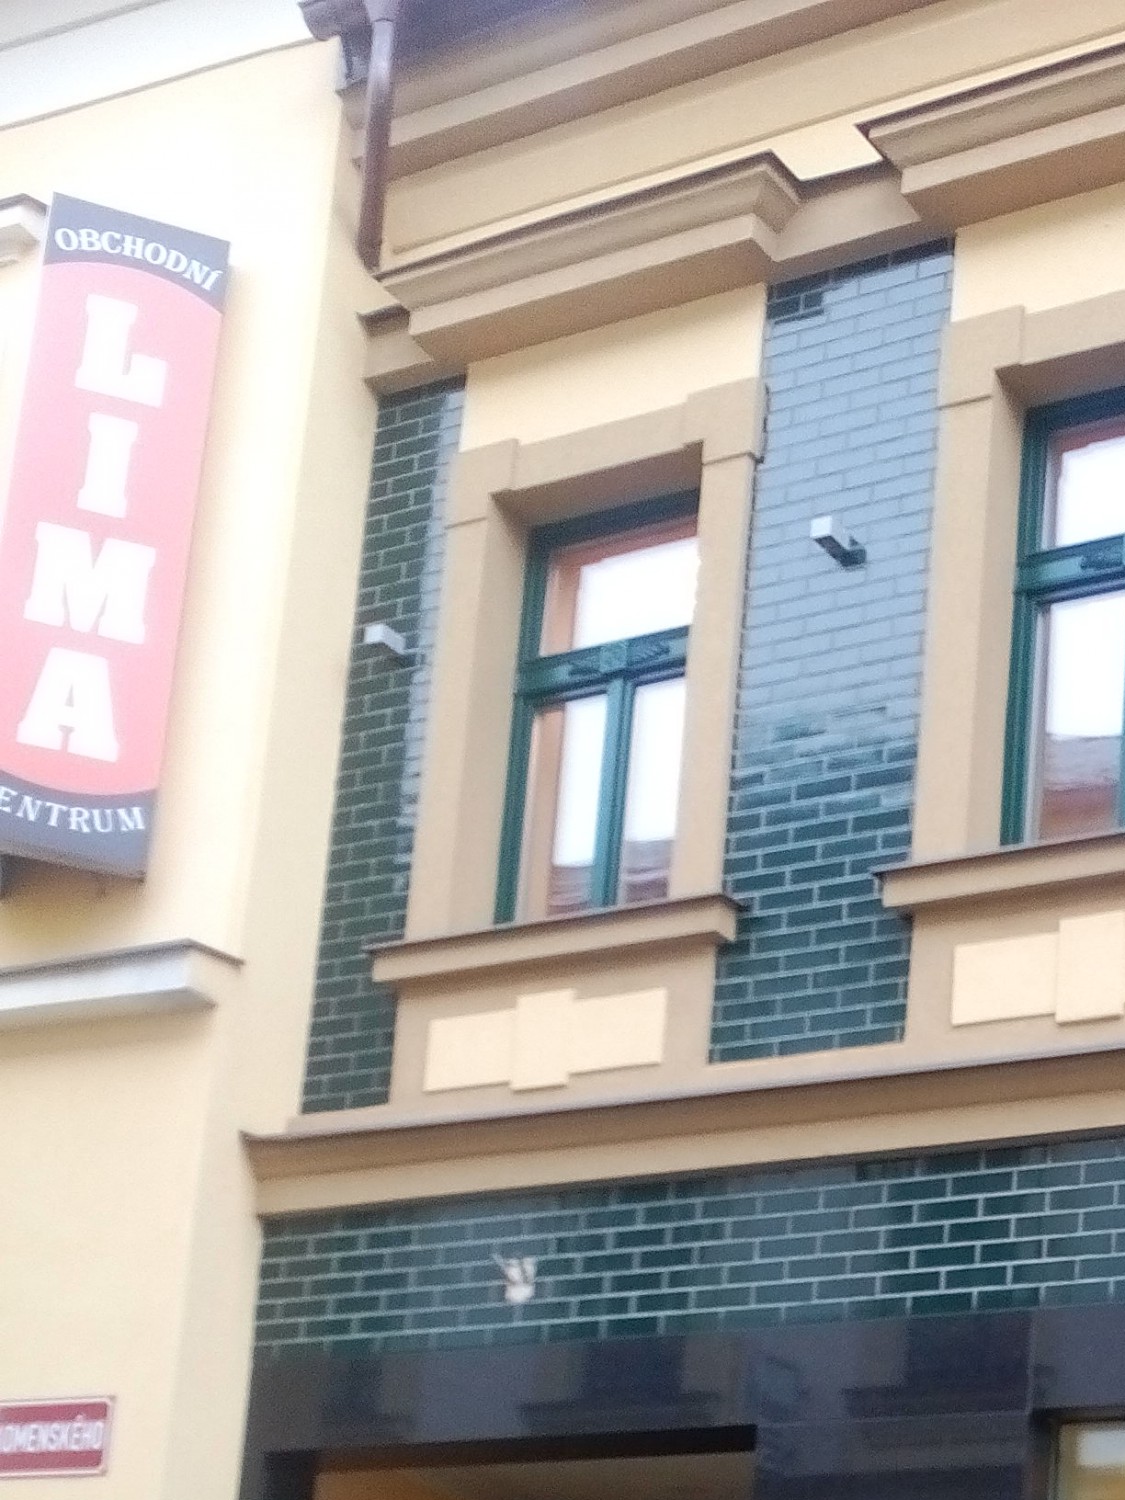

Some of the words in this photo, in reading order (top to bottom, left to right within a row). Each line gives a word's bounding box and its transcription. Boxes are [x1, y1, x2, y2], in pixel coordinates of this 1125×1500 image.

[54, 227, 223, 291] OBCHODNÍ
[16, 293, 168, 763] LIMA
[0, 785, 146, 833] ENTRUM
[0, 1414, 104, 1453] OMENSKÉHO
